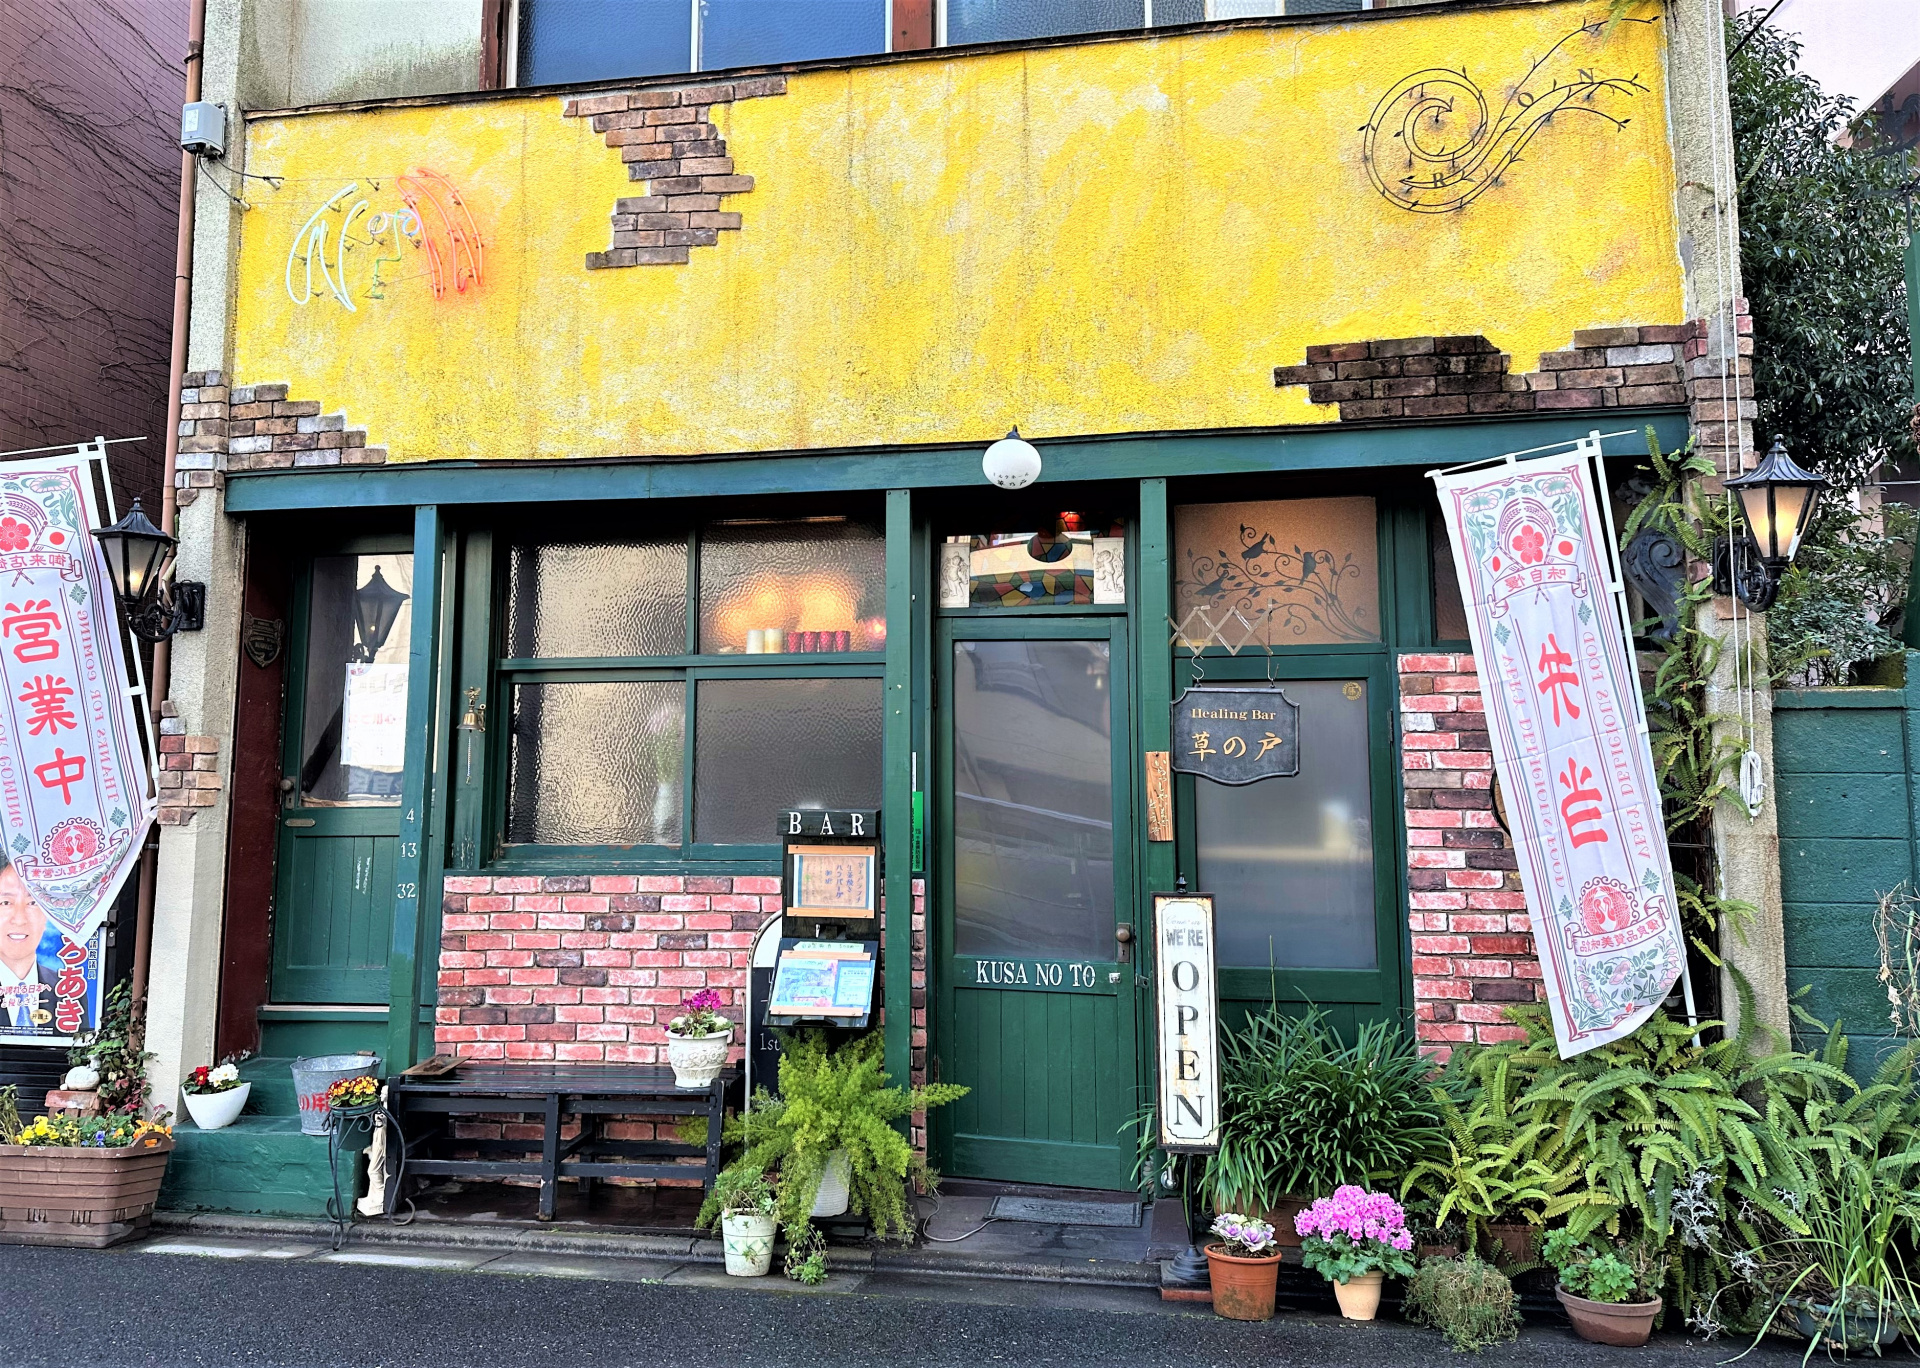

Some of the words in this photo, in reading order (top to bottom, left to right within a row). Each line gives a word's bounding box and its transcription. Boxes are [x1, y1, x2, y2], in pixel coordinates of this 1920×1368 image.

[1191, 708, 1248, 722] Healing
[1252, 709, 1276, 720] Bar
[1188, 731, 1283, 762] 草の戸
[406, 808, 415, 824] 4
[788, 812, 865, 836] BAR
[400, 842, 417, 858] 13
[397, 883, 416, 900] 32
[1166, 928, 1203, 947] WE'RE
[976, 960, 1028, 984] KUSA
[1036, 963, 1063, 986] NO
[1069, 964, 1095, 988] TO
[1172, 960, 1206, 1127] OPEN
